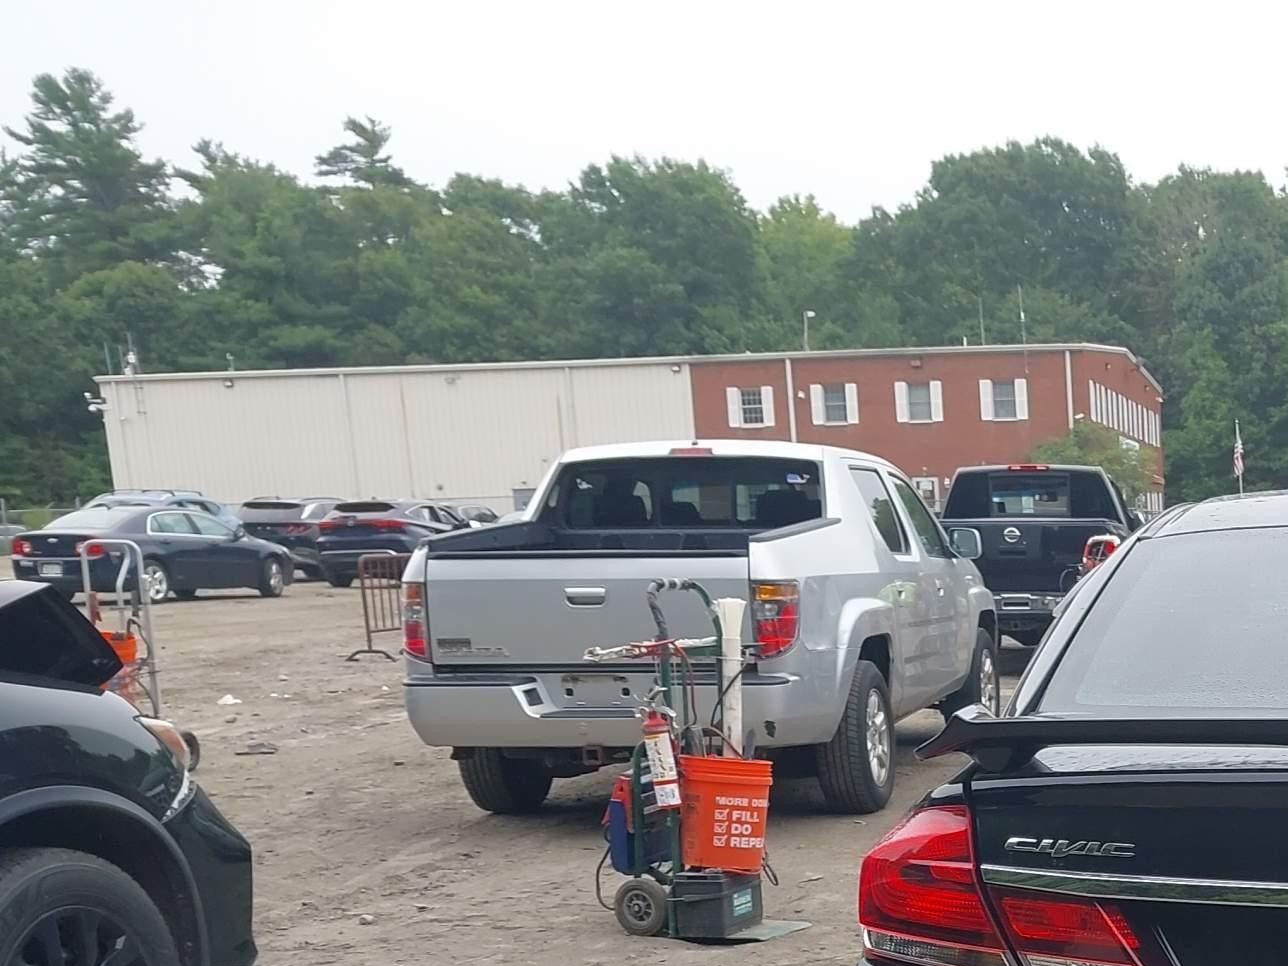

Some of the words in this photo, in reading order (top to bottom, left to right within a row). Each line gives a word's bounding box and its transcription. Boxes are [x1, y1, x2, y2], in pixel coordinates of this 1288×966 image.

[732, 810, 760, 823] FILL
[730, 823, 752, 835] DO
[1004, 836, 1137, 858] CIVIC
